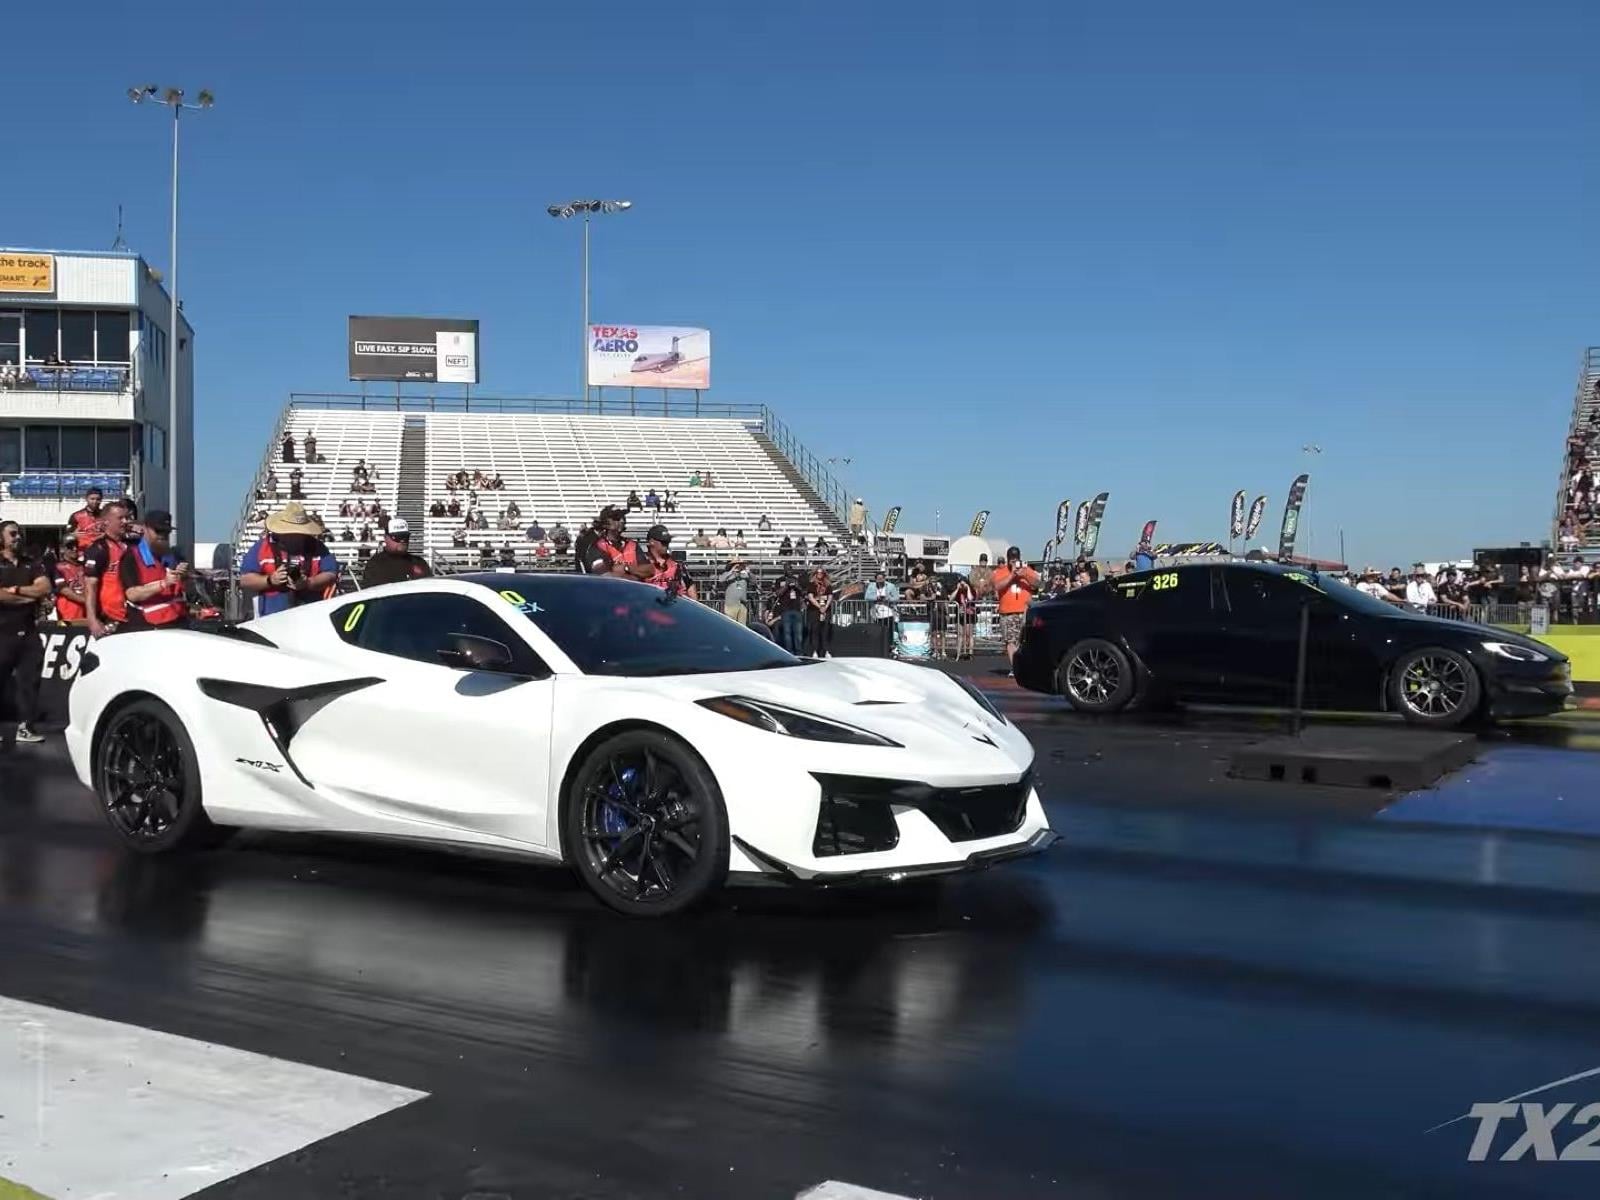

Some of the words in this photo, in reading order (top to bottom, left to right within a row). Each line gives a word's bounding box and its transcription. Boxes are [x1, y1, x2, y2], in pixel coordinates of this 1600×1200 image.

[592, 327, 638, 339] TEXAS
[358, 344, 376, 352] LIVE
[376, 345, 397, 353] FAST.
[398, 345, 410, 353] SIP
[411, 346, 436, 354] SLOW.
[592, 339, 639, 353] AERO
[447, 357, 467, 366] NEFT
[1153, 573, 1178, 590] 326
